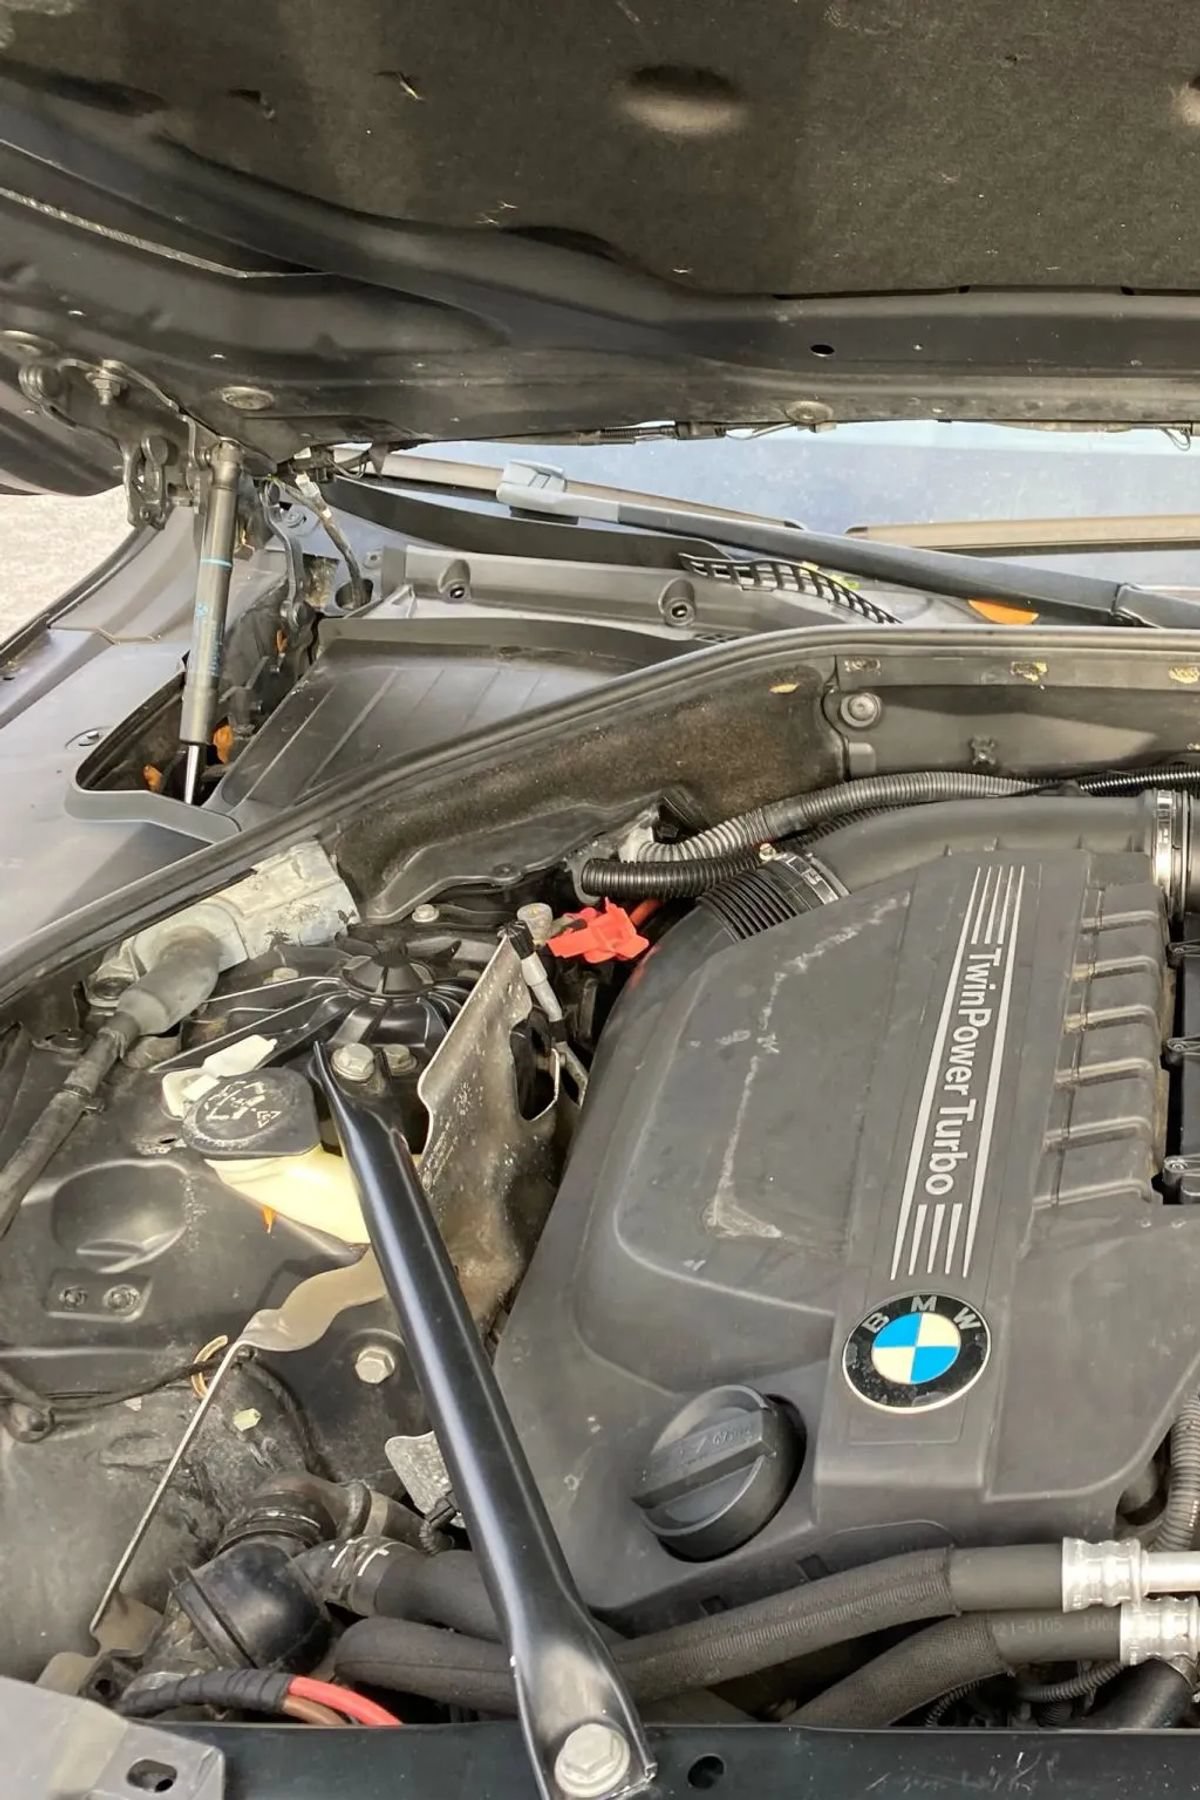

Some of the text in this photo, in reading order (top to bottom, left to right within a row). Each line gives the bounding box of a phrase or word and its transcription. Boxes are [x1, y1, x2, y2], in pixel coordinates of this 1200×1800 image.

[924, 947, 1003, 1196] TwinPower Turbo
[861, 1295, 982, 1334] BMW
